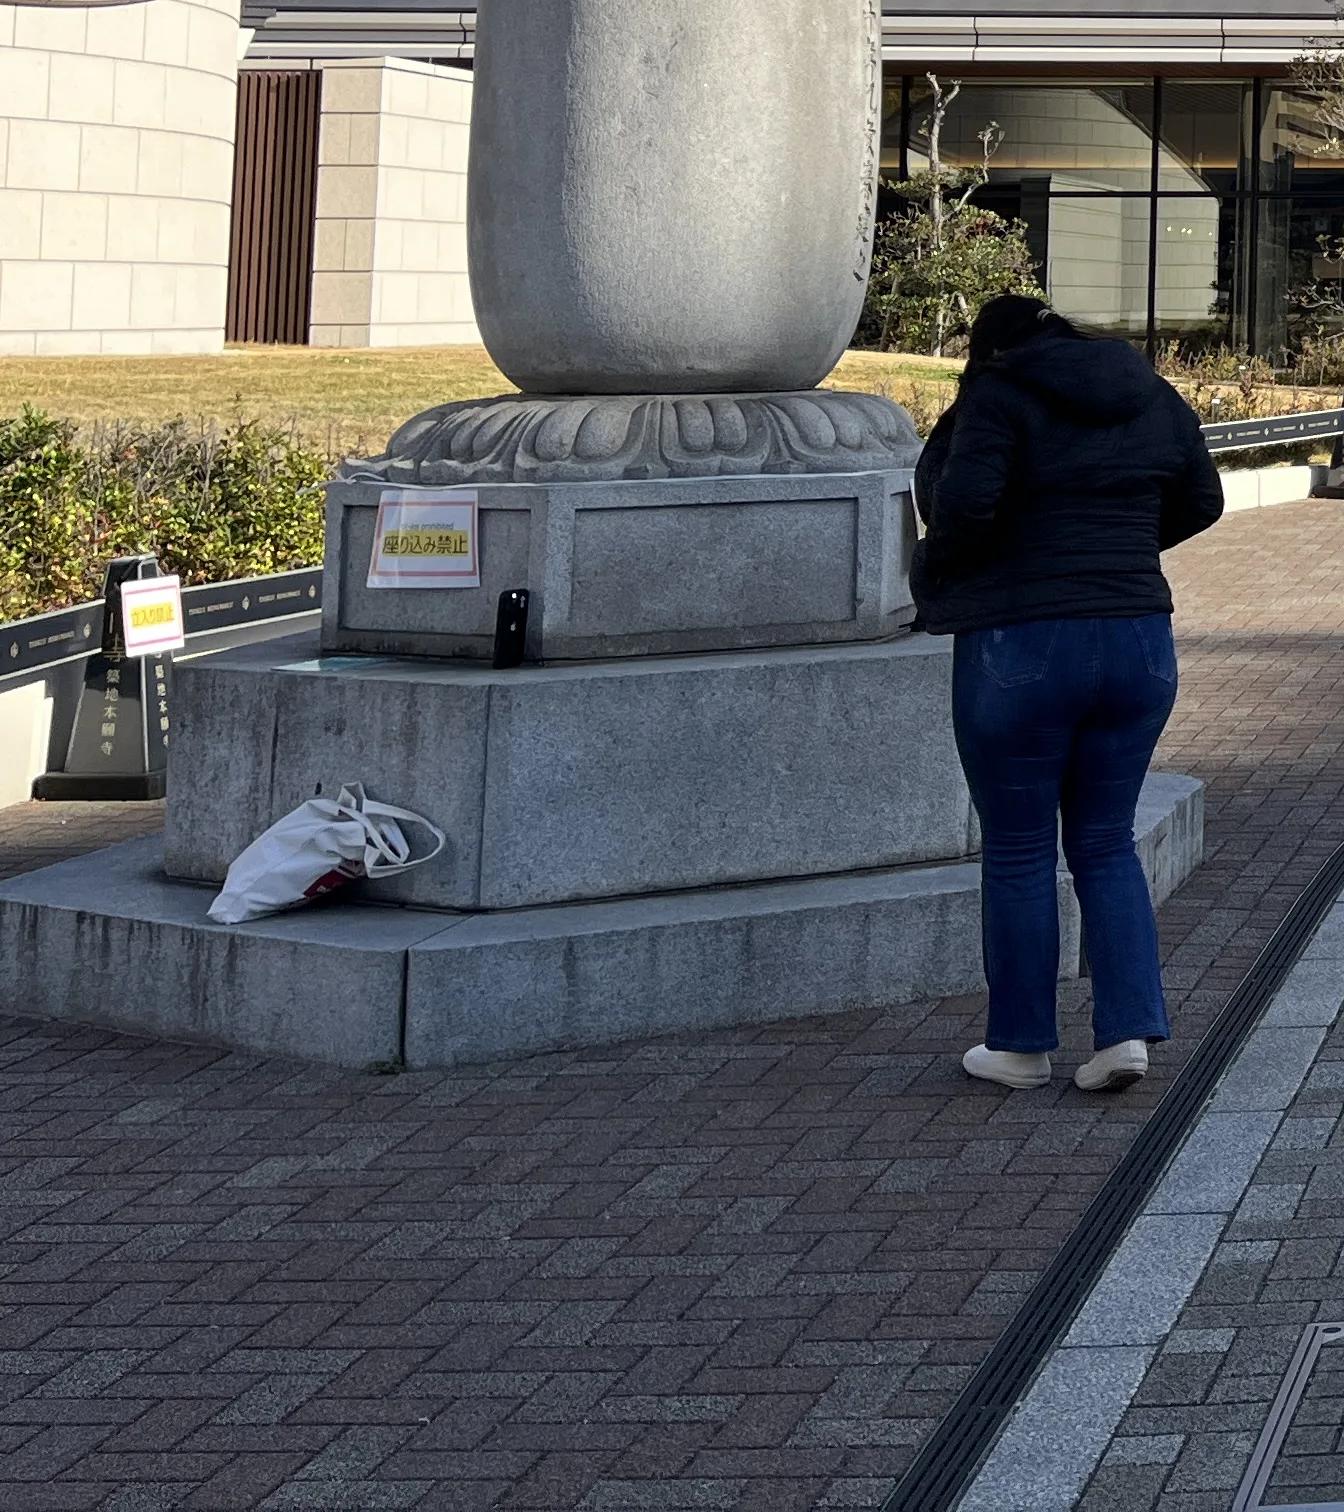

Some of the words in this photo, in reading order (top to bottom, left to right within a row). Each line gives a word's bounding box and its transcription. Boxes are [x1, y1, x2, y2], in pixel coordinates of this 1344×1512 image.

[383, 534, 469, 555] 座り込み禁止
